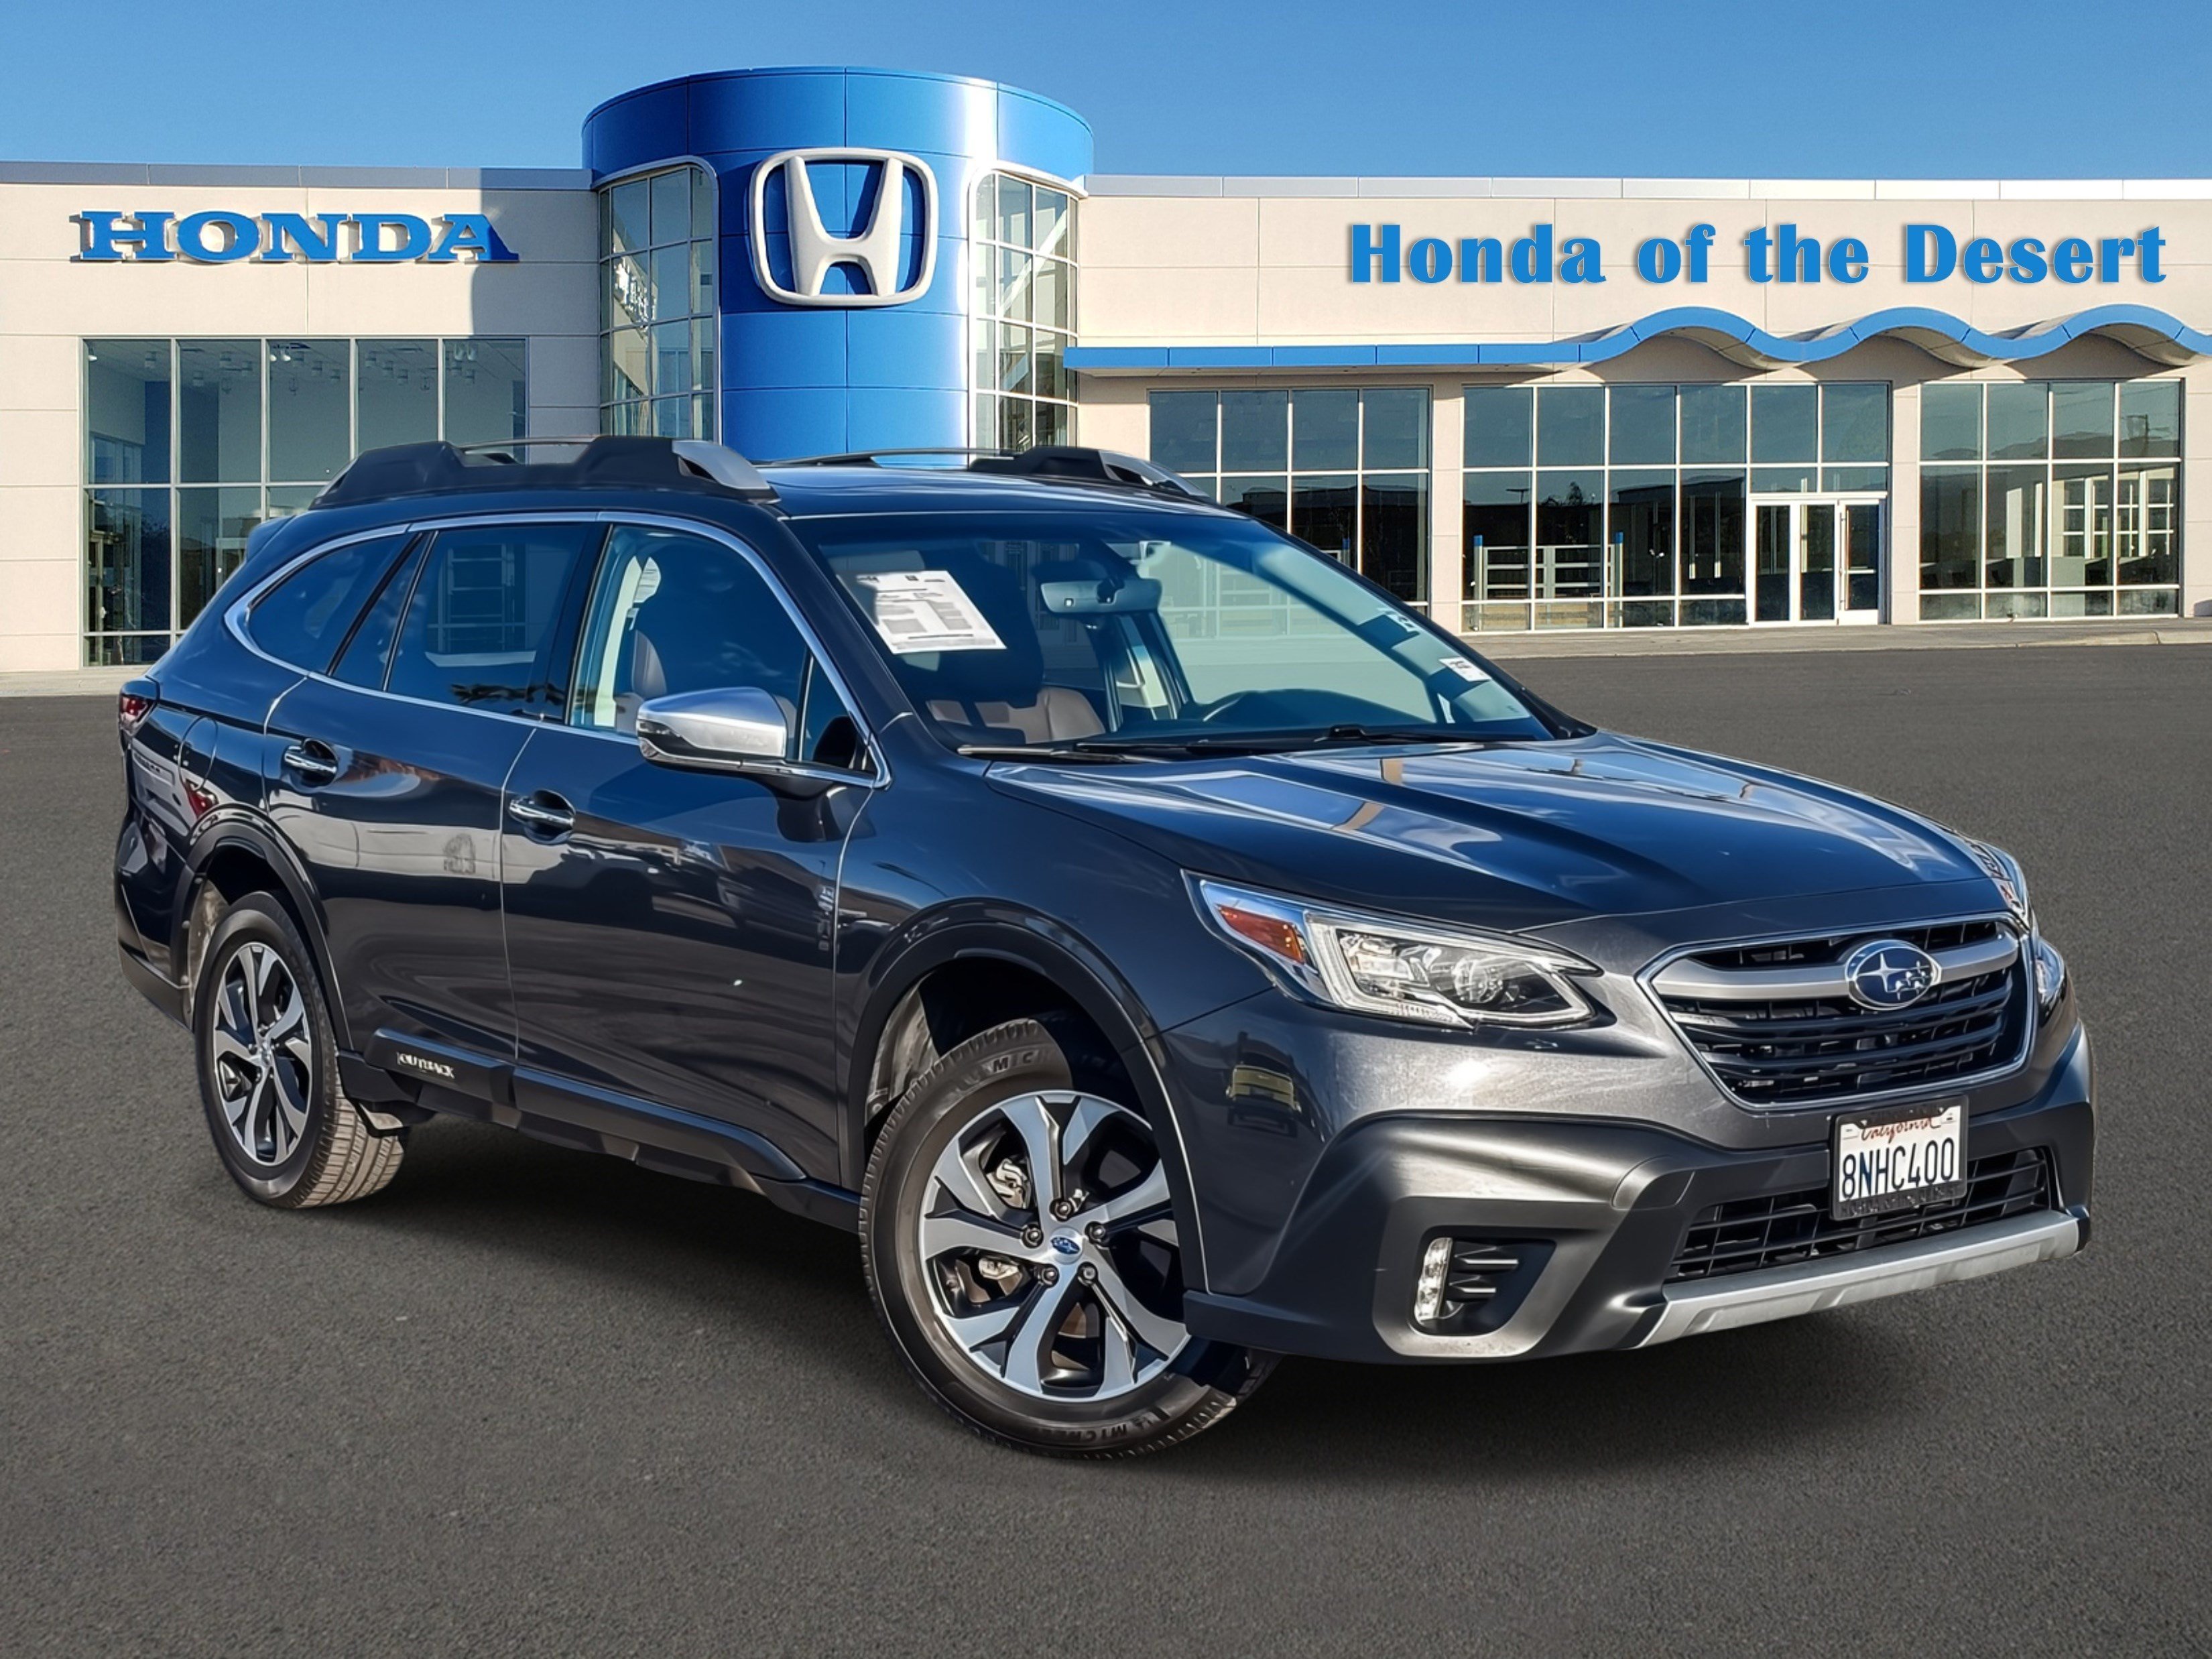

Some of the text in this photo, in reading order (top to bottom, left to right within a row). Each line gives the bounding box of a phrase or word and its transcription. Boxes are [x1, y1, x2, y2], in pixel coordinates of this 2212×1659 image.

[72, 210, 519, 263] HONDA
[1351, 224, 2166, 284] Honda of the Desert
[1842, 1138, 1955, 1199] 8NHC400
